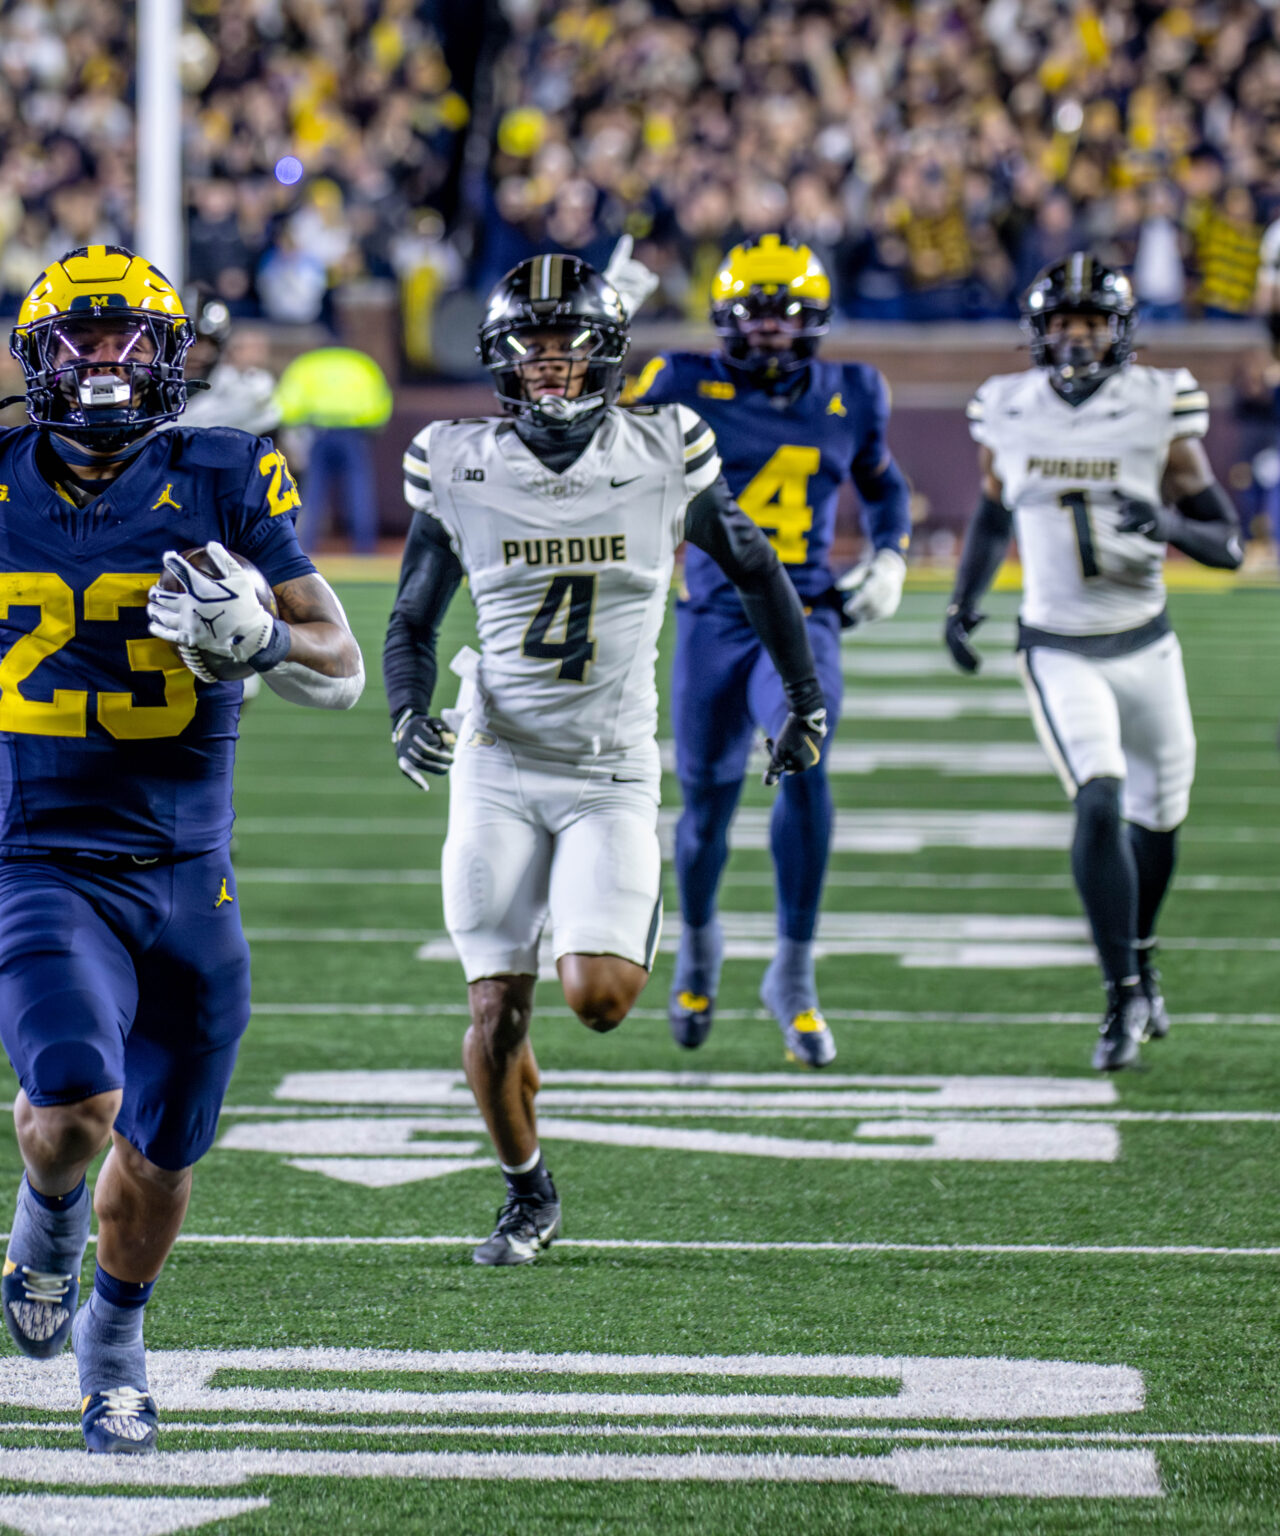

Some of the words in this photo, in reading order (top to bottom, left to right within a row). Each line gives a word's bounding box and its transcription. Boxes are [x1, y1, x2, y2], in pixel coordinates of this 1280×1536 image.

[90, 296, 109, 307] M
[1026, 457, 1119, 480] PURDUE
[737, 445, 821, 565] 4
[1058, 487, 1100, 581] 1
[502, 533, 627, 567] PURDUE
[522, 571, 599, 686] 4
